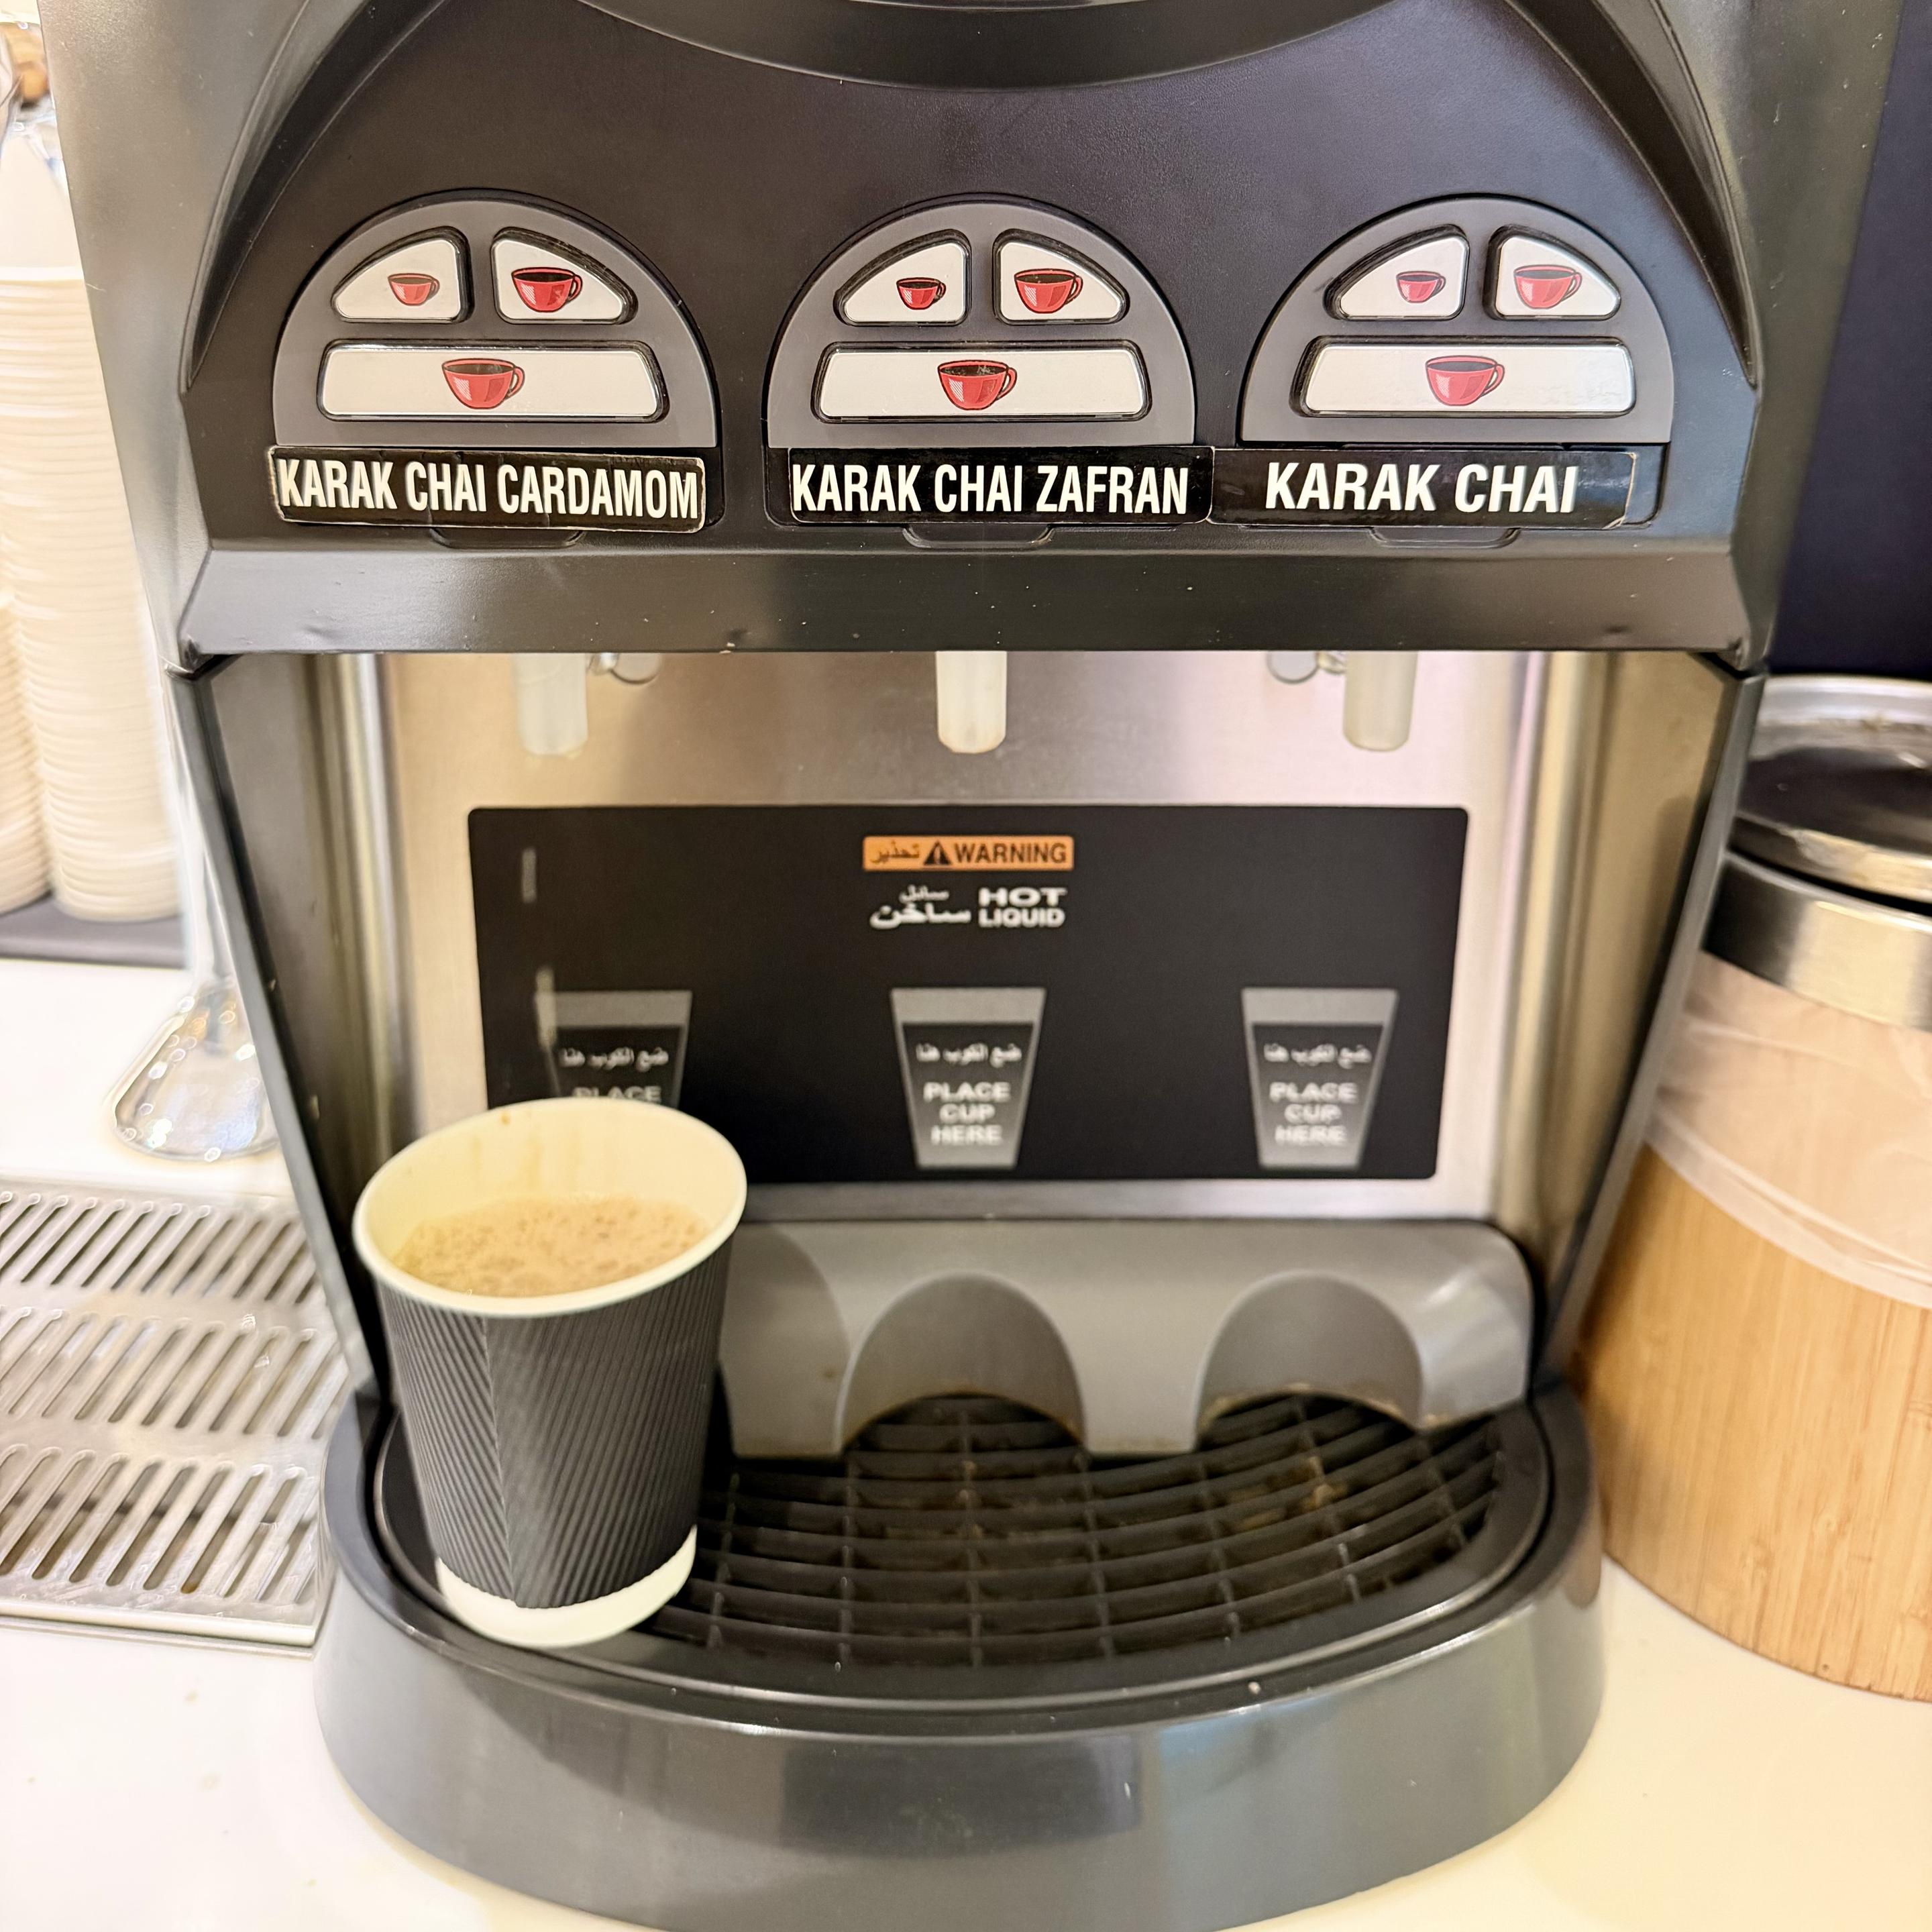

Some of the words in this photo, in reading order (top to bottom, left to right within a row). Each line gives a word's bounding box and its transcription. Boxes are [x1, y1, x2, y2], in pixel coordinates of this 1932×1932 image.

[276, 459, 398, 510] KARAK
[407, 462, 487, 512] CHAI
[497, 466, 698, 519] CARDAMOM
[792, 464, 922, 512] KARAK
[934, 464, 1022, 513] CHAI
[1036, 465, 1189, 515] ZAFRAN
[1265, 462, 1440, 512] KARAK
[1454, 465, 1579, 514] CHAI
[870, 841, 920, 864] تحذير
[954, 843, 1067, 863] WARNING
[900, 885, 949, 902] سائل
[979, 888, 1068, 907] HOT
[869, 903, 972, 930] ساخن
[979, 908, 1065, 928] LIQUID
[923, 1081, 1011, 1103] PLACE
[1269, 1081, 1358, 1104] PLACE
[940, 1104, 996, 1124] CUP
[1284, 1104, 1341, 1125] CUP
[930, 1124, 1004, 1146] HERE
